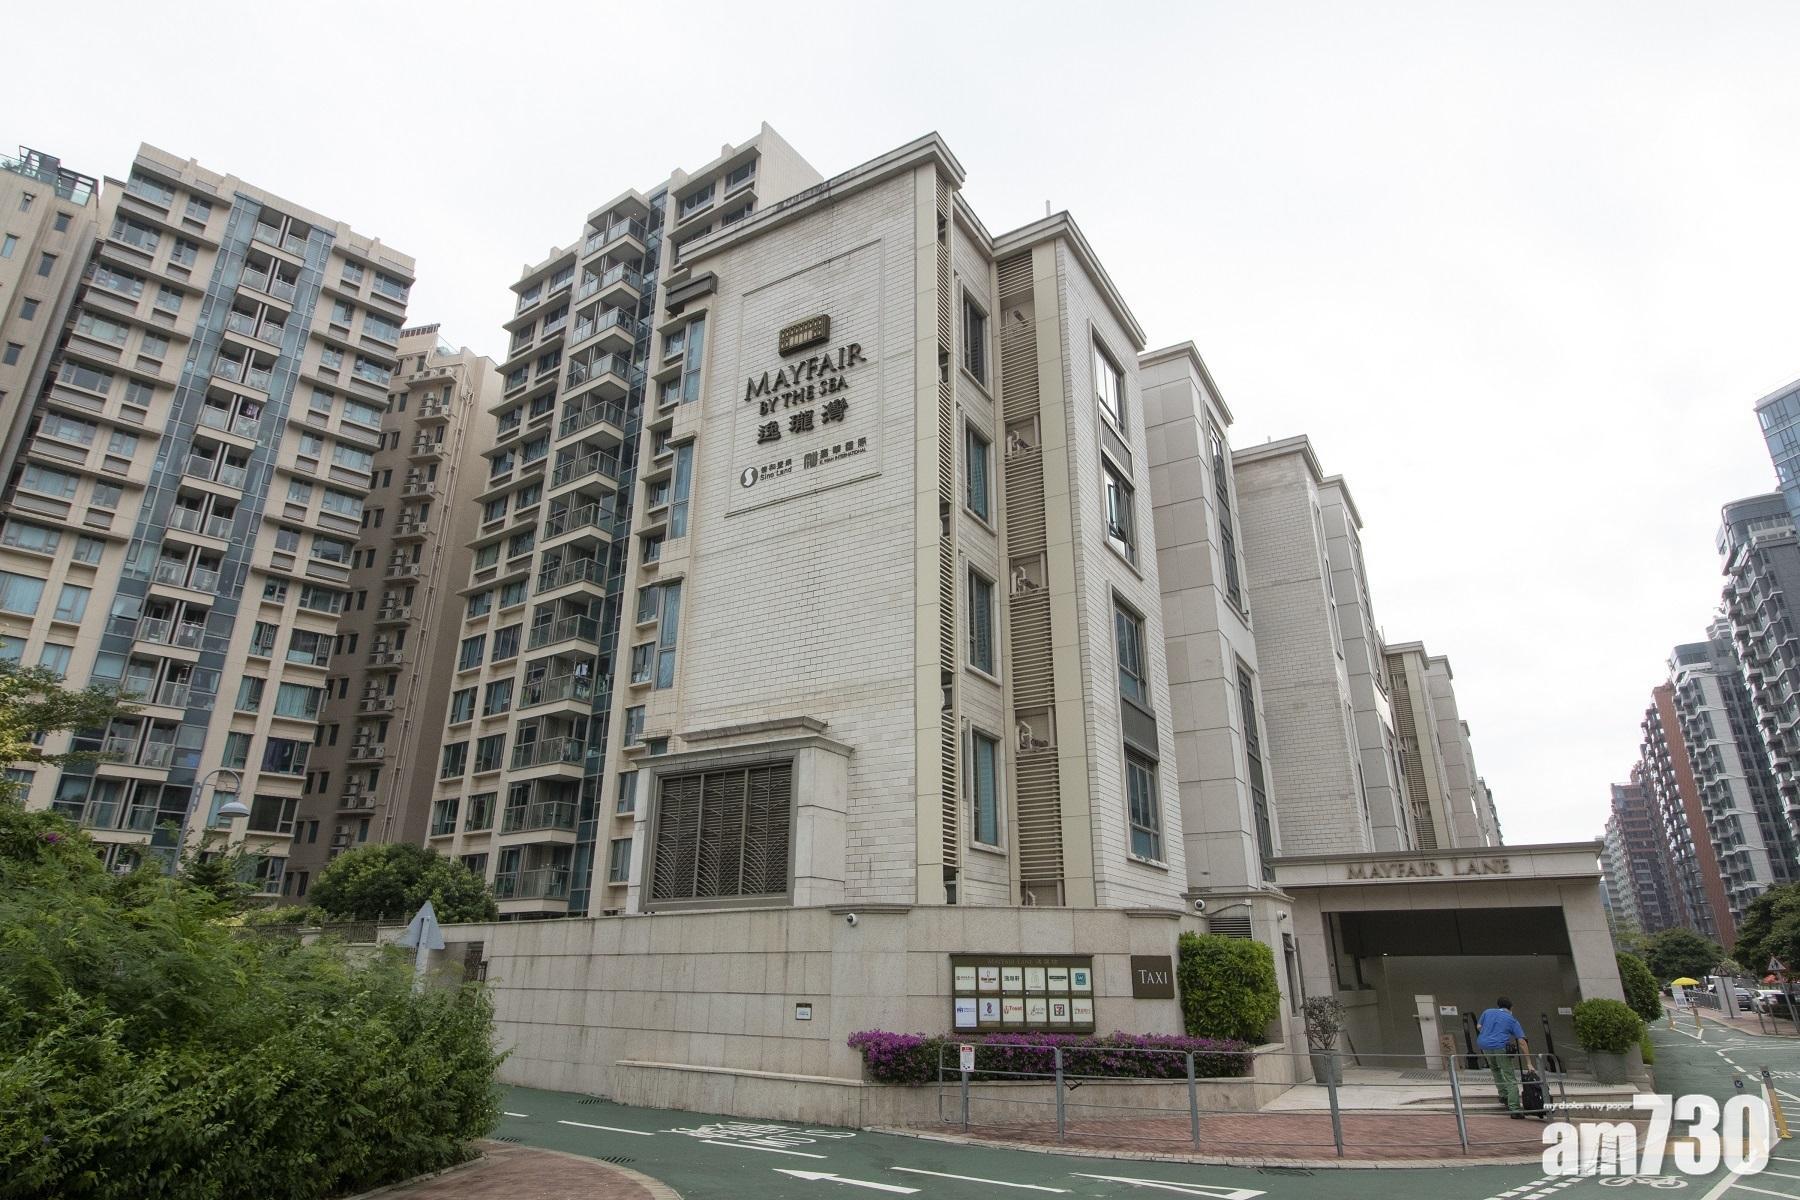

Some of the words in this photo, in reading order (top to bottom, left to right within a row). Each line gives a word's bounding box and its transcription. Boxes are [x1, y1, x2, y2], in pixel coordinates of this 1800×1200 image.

[743, 342, 867, 402] MAYFAIR
[760, 397, 779, 416] BY
[781, 385, 815, 408] THE
[819, 375, 848, 396] SEA
[760, 472, 775, 481] Sino
[776, 466, 793, 476] Land
[1346, 861, 1443, 880] MAYFAIR
[1450, 857, 1512, 876] LANE
[1138, 969, 1168, 984] TAXI
